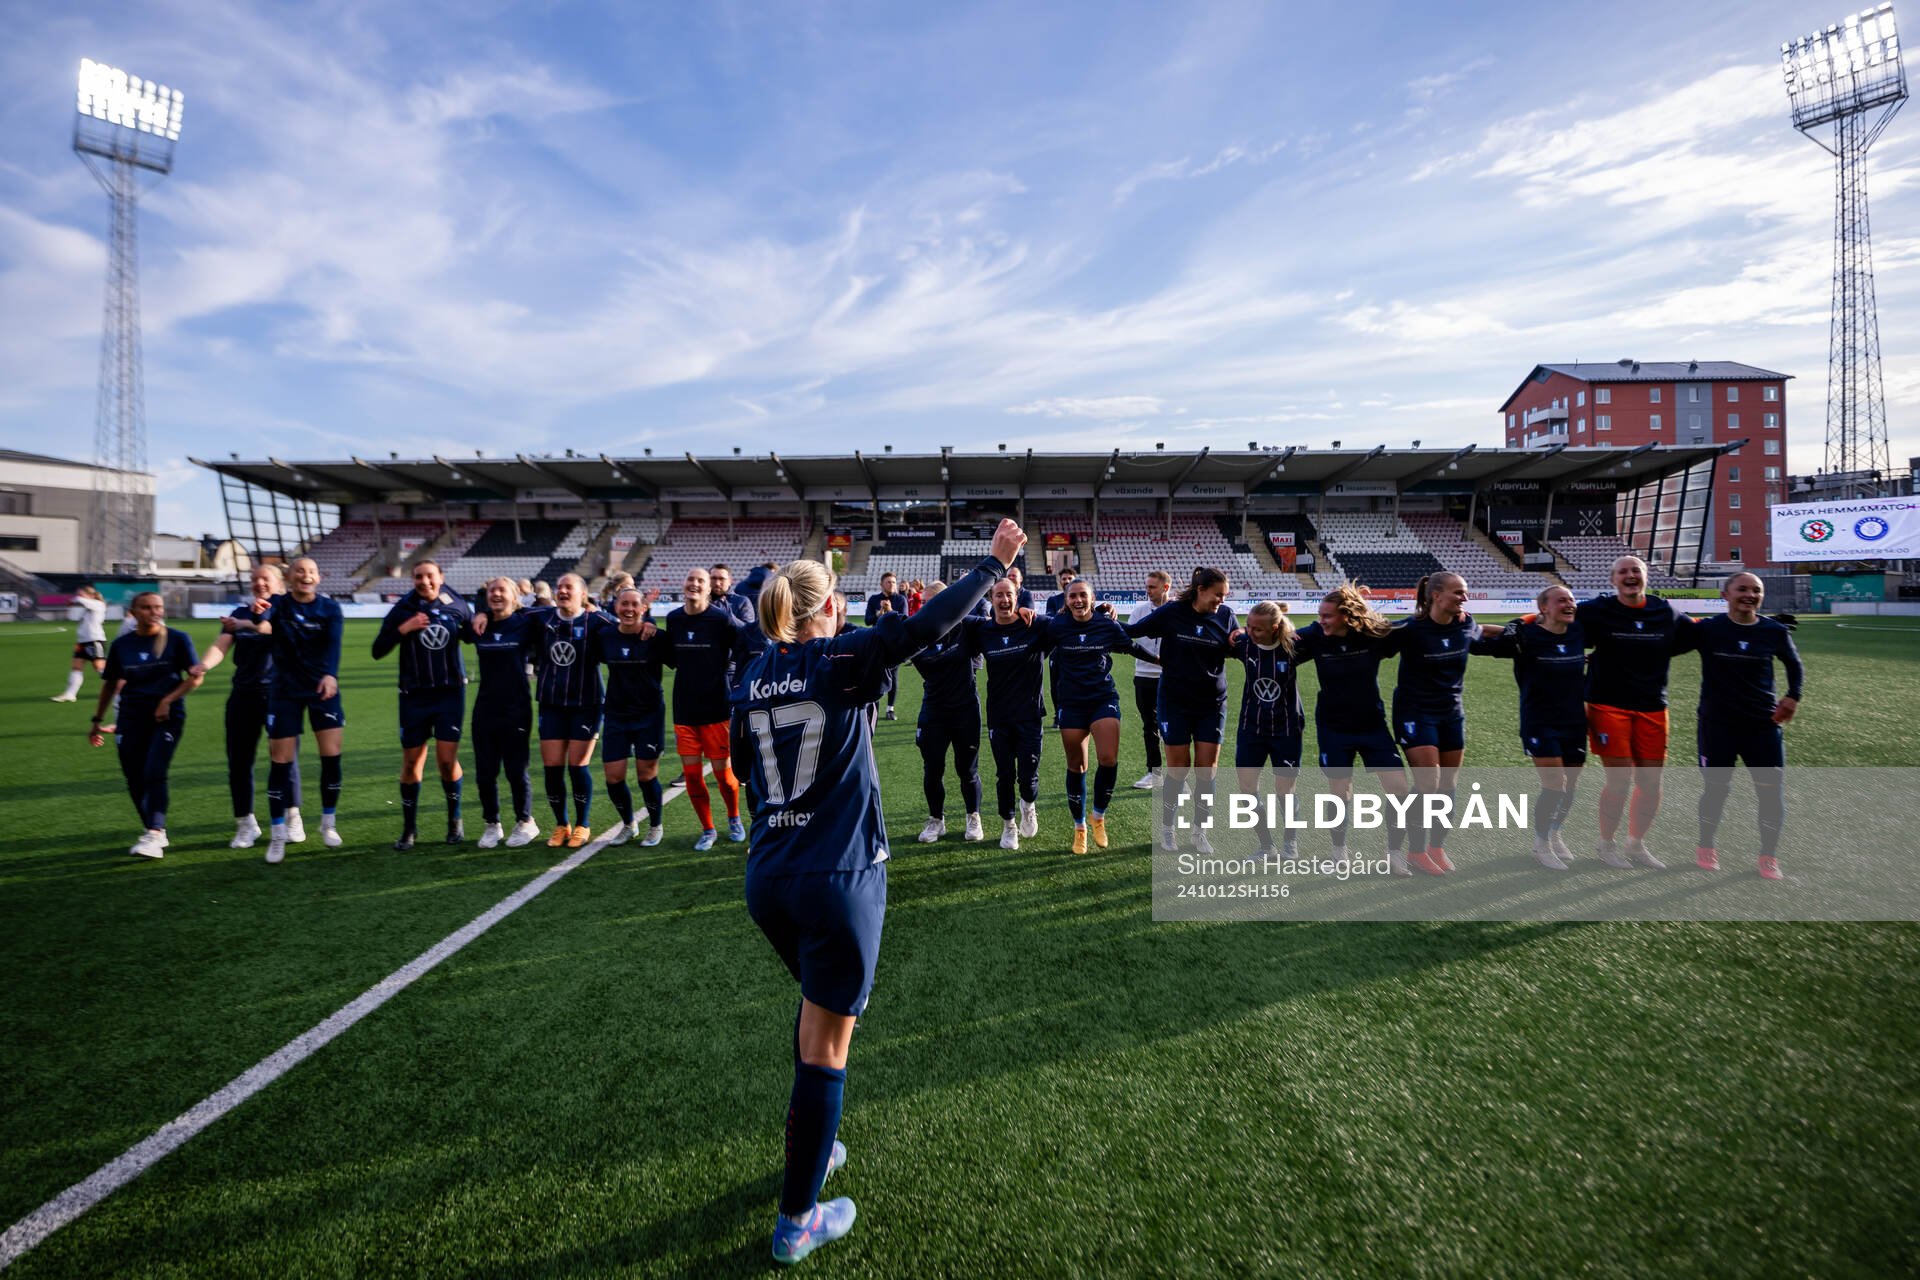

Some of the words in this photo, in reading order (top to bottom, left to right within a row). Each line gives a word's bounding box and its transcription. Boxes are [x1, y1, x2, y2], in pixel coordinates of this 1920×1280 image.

[966, 487, 1004, 496] starkare
[1051, 487, 1068, 495] och
[1114, 486, 1154, 495] växande
[1192, 485, 1226, 494] Örebro!
[1777, 508, 1815, 517] NÄSTA
[1818, 503, 1916, 514] HEMMAMATCH
[1103, 593, 1122, 601] Care
[1133, 592, 1148, 601] Bed
[748, 700, 826, 805] 17
